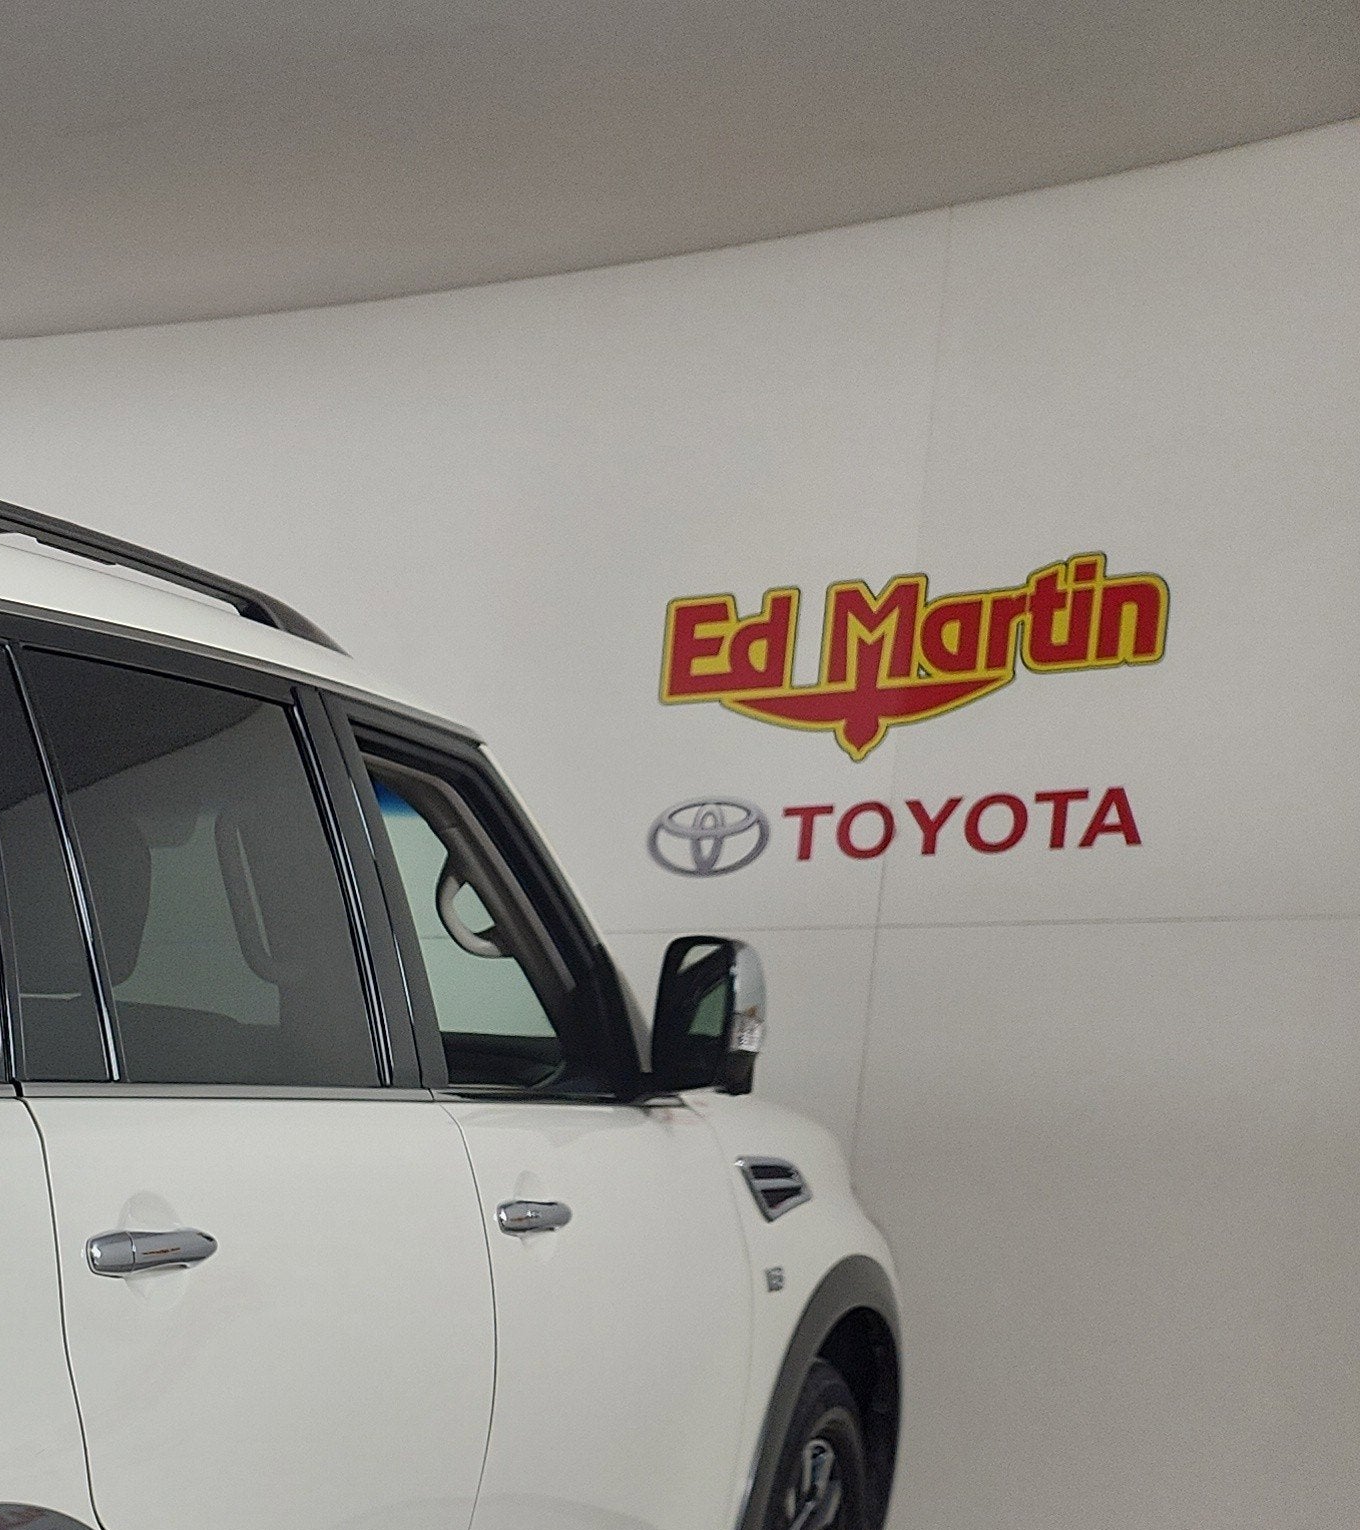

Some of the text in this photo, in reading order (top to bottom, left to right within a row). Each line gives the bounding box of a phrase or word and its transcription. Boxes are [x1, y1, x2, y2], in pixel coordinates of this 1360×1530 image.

[666, 561, 1163, 697] Ed Martin
[783, 786, 1142, 861] TOYOTA
